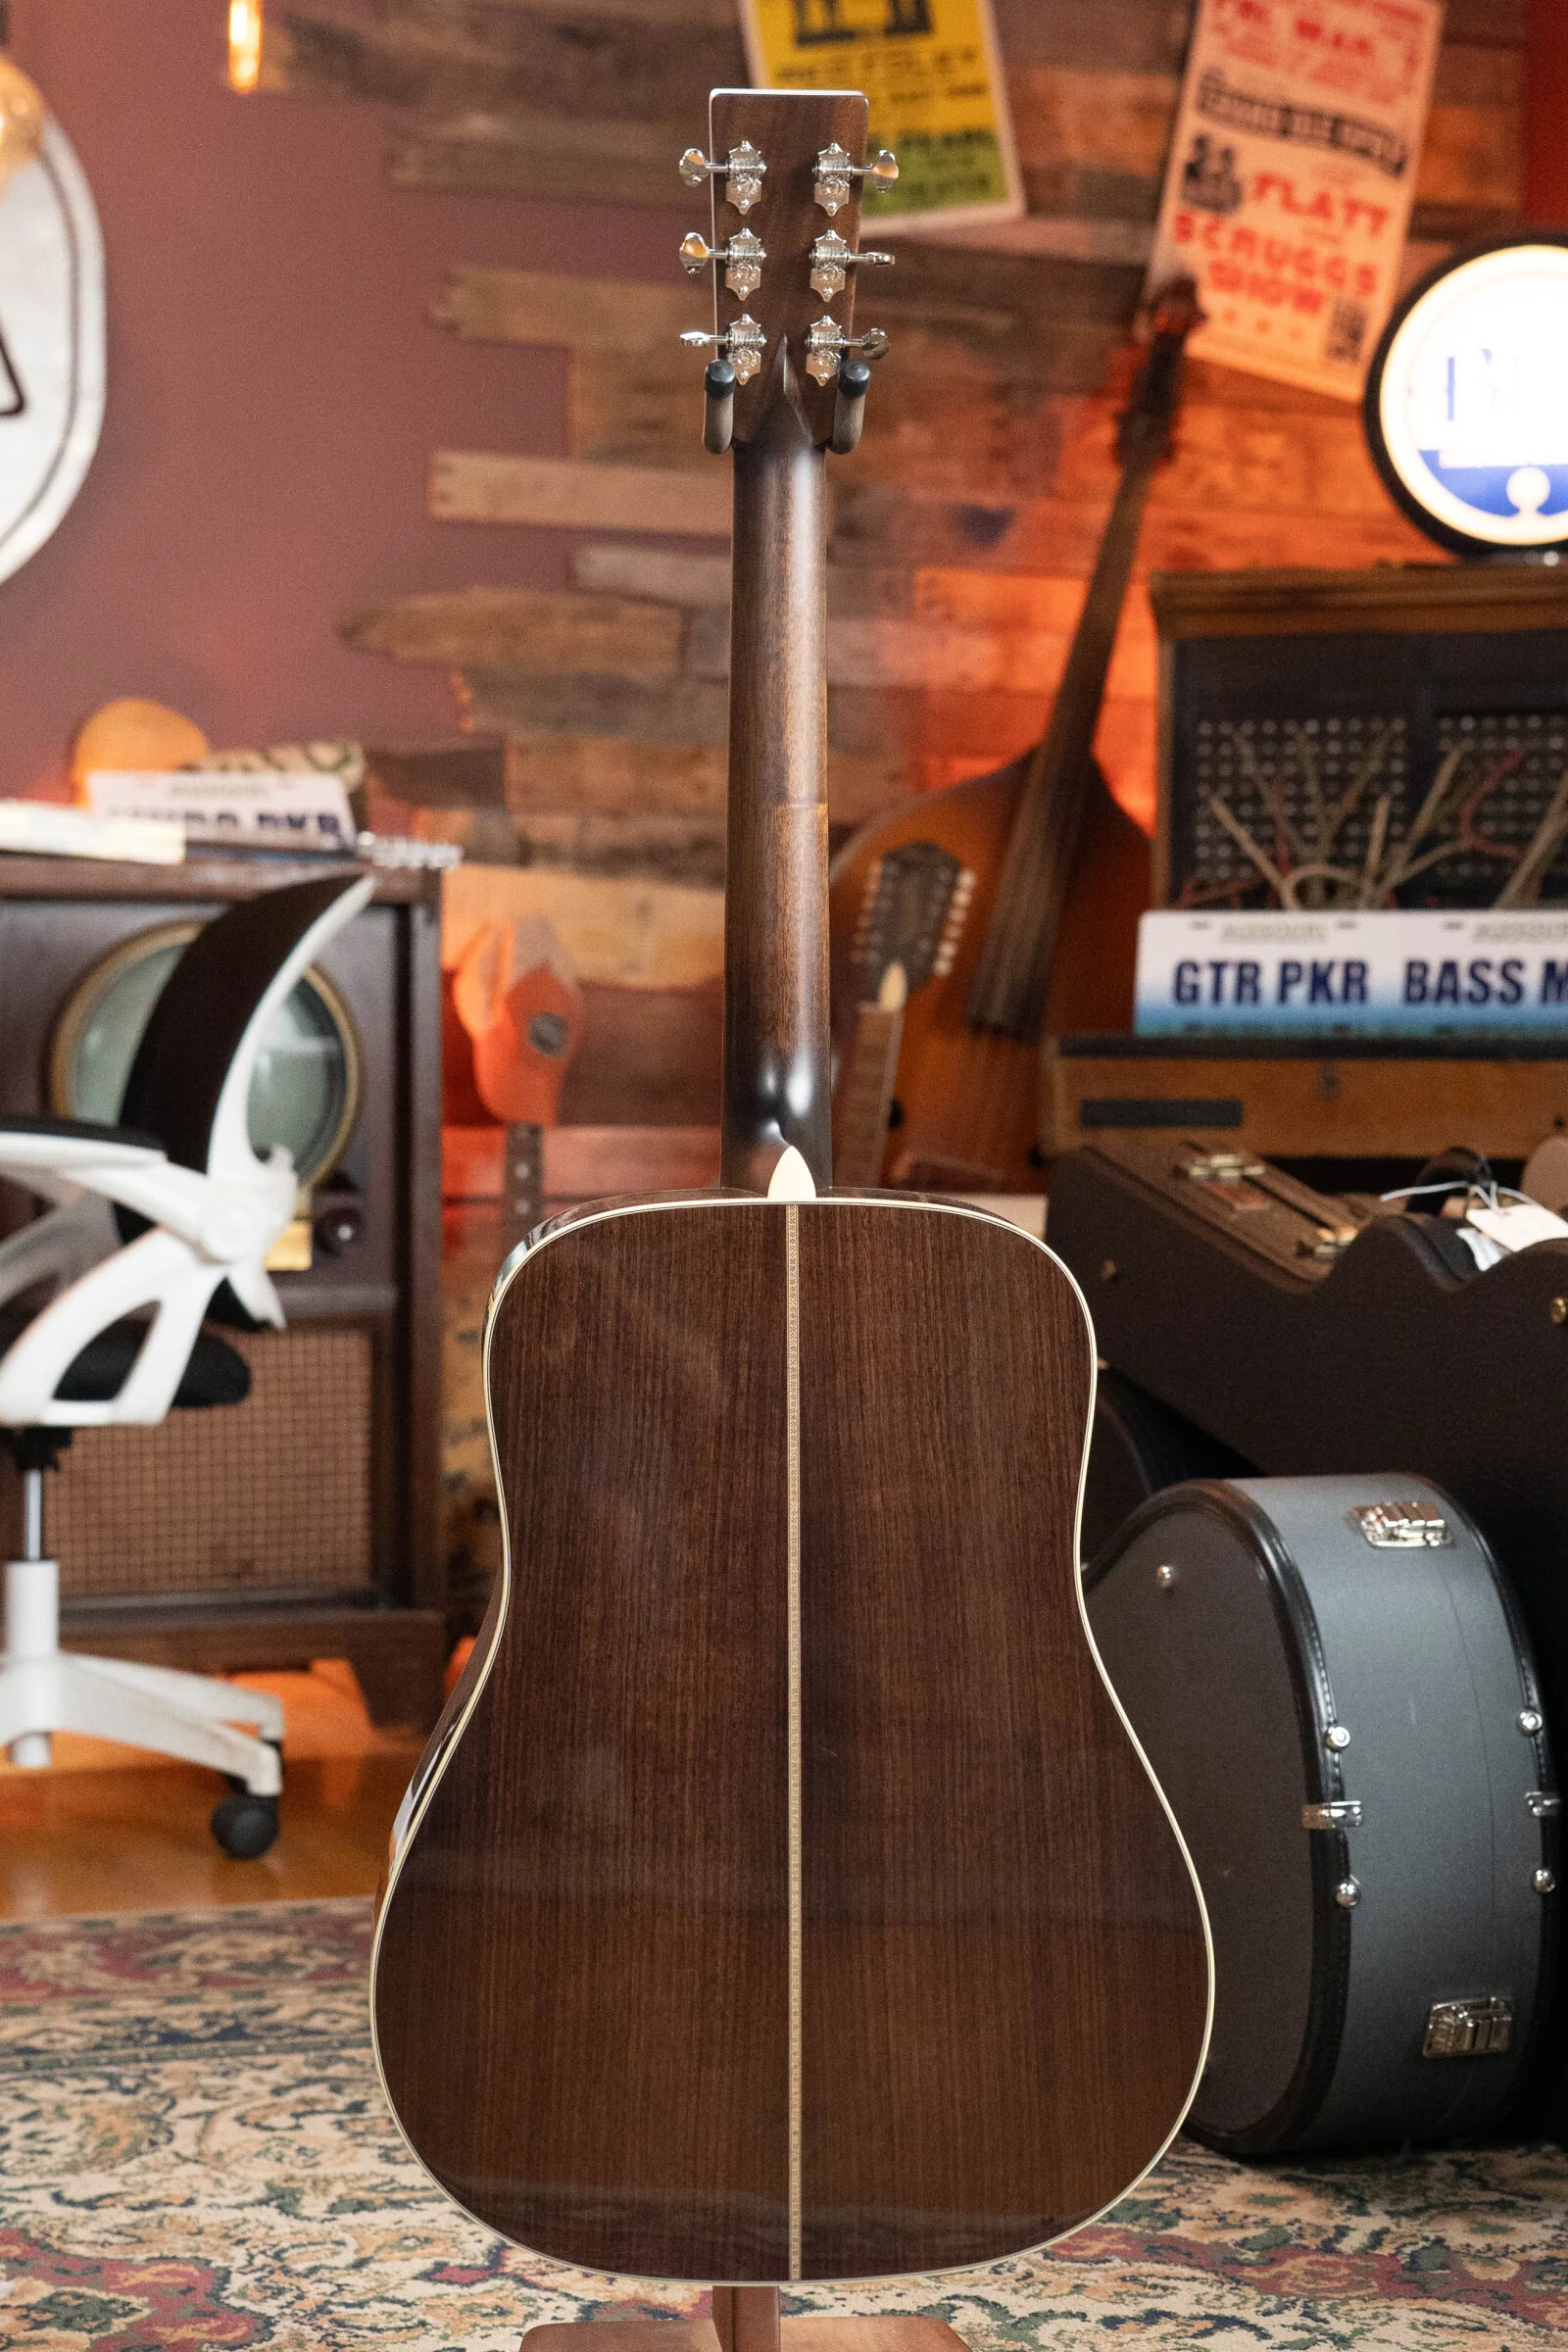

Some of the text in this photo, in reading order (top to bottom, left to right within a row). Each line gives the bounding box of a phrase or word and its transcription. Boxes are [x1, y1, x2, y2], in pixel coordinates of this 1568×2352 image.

[1253, 172, 1390, 239] FLATT
[1173, 959, 1368, 1005] GTR PKR
[1403, 959, 1525, 1005] BASS
